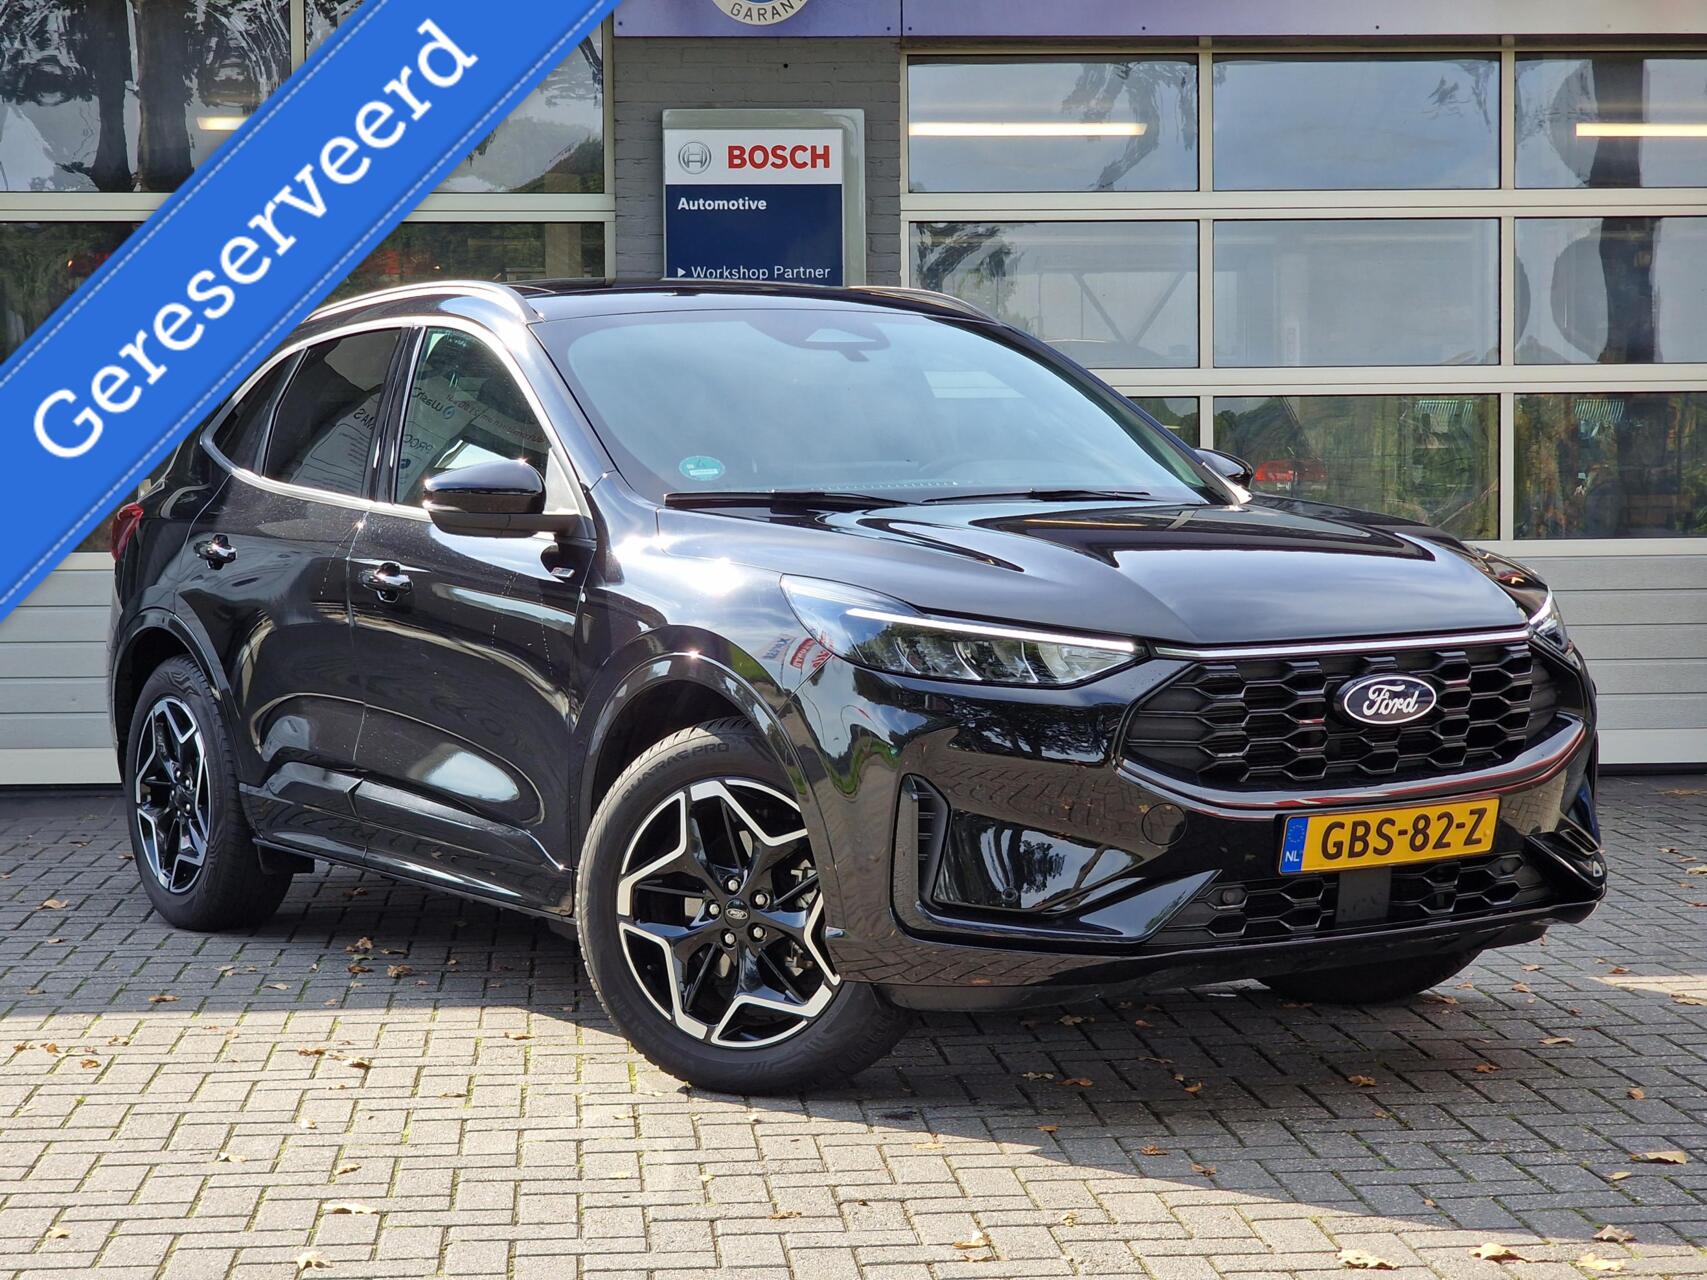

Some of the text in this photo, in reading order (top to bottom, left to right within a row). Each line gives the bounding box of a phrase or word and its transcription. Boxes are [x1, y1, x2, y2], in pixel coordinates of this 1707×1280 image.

[730, 0, 802, 22] GARAN
[727, 145, 830, 169] BOSCH
[677, 197, 767, 211] Automotive
[691, 266, 831, 280] Workshop Partner
[1362, 684, 1419, 716] Ford
[1321, 807, 1487, 860] GBS-82-Z
[1285, 851, 1300, 862] NL
